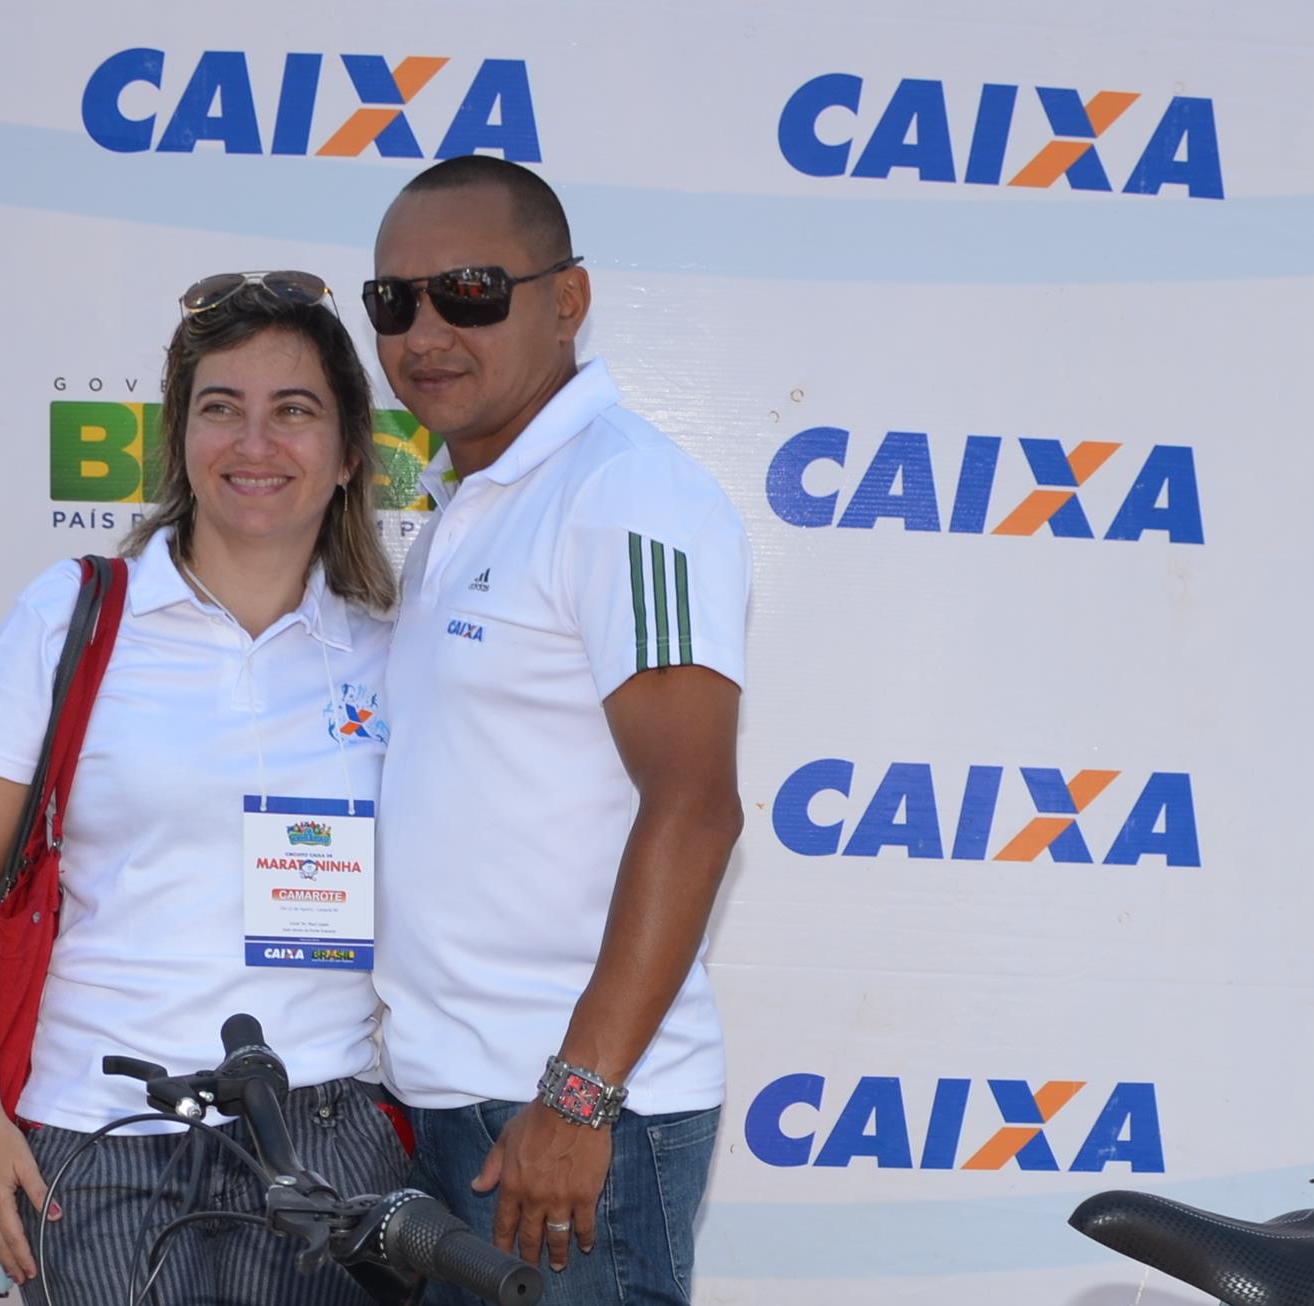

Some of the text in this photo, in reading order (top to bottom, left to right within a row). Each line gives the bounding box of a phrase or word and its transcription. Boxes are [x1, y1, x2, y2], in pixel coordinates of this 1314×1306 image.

[81, 47, 543, 163] CAIXA
[777, 72, 1226, 200] CAIXA
[52, 509, 115, 530] PAÍS
[765, 426, 1205, 545] CAIXA
[447, 619, 483, 642] CAIXA
[772, 758, 1202, 868] CAIXA
[278, 889, 344, 902] CAMAROTE
[264, 947, 305, 960] CAIXA
[744, 1072, 1166, 1174] CAIXA
